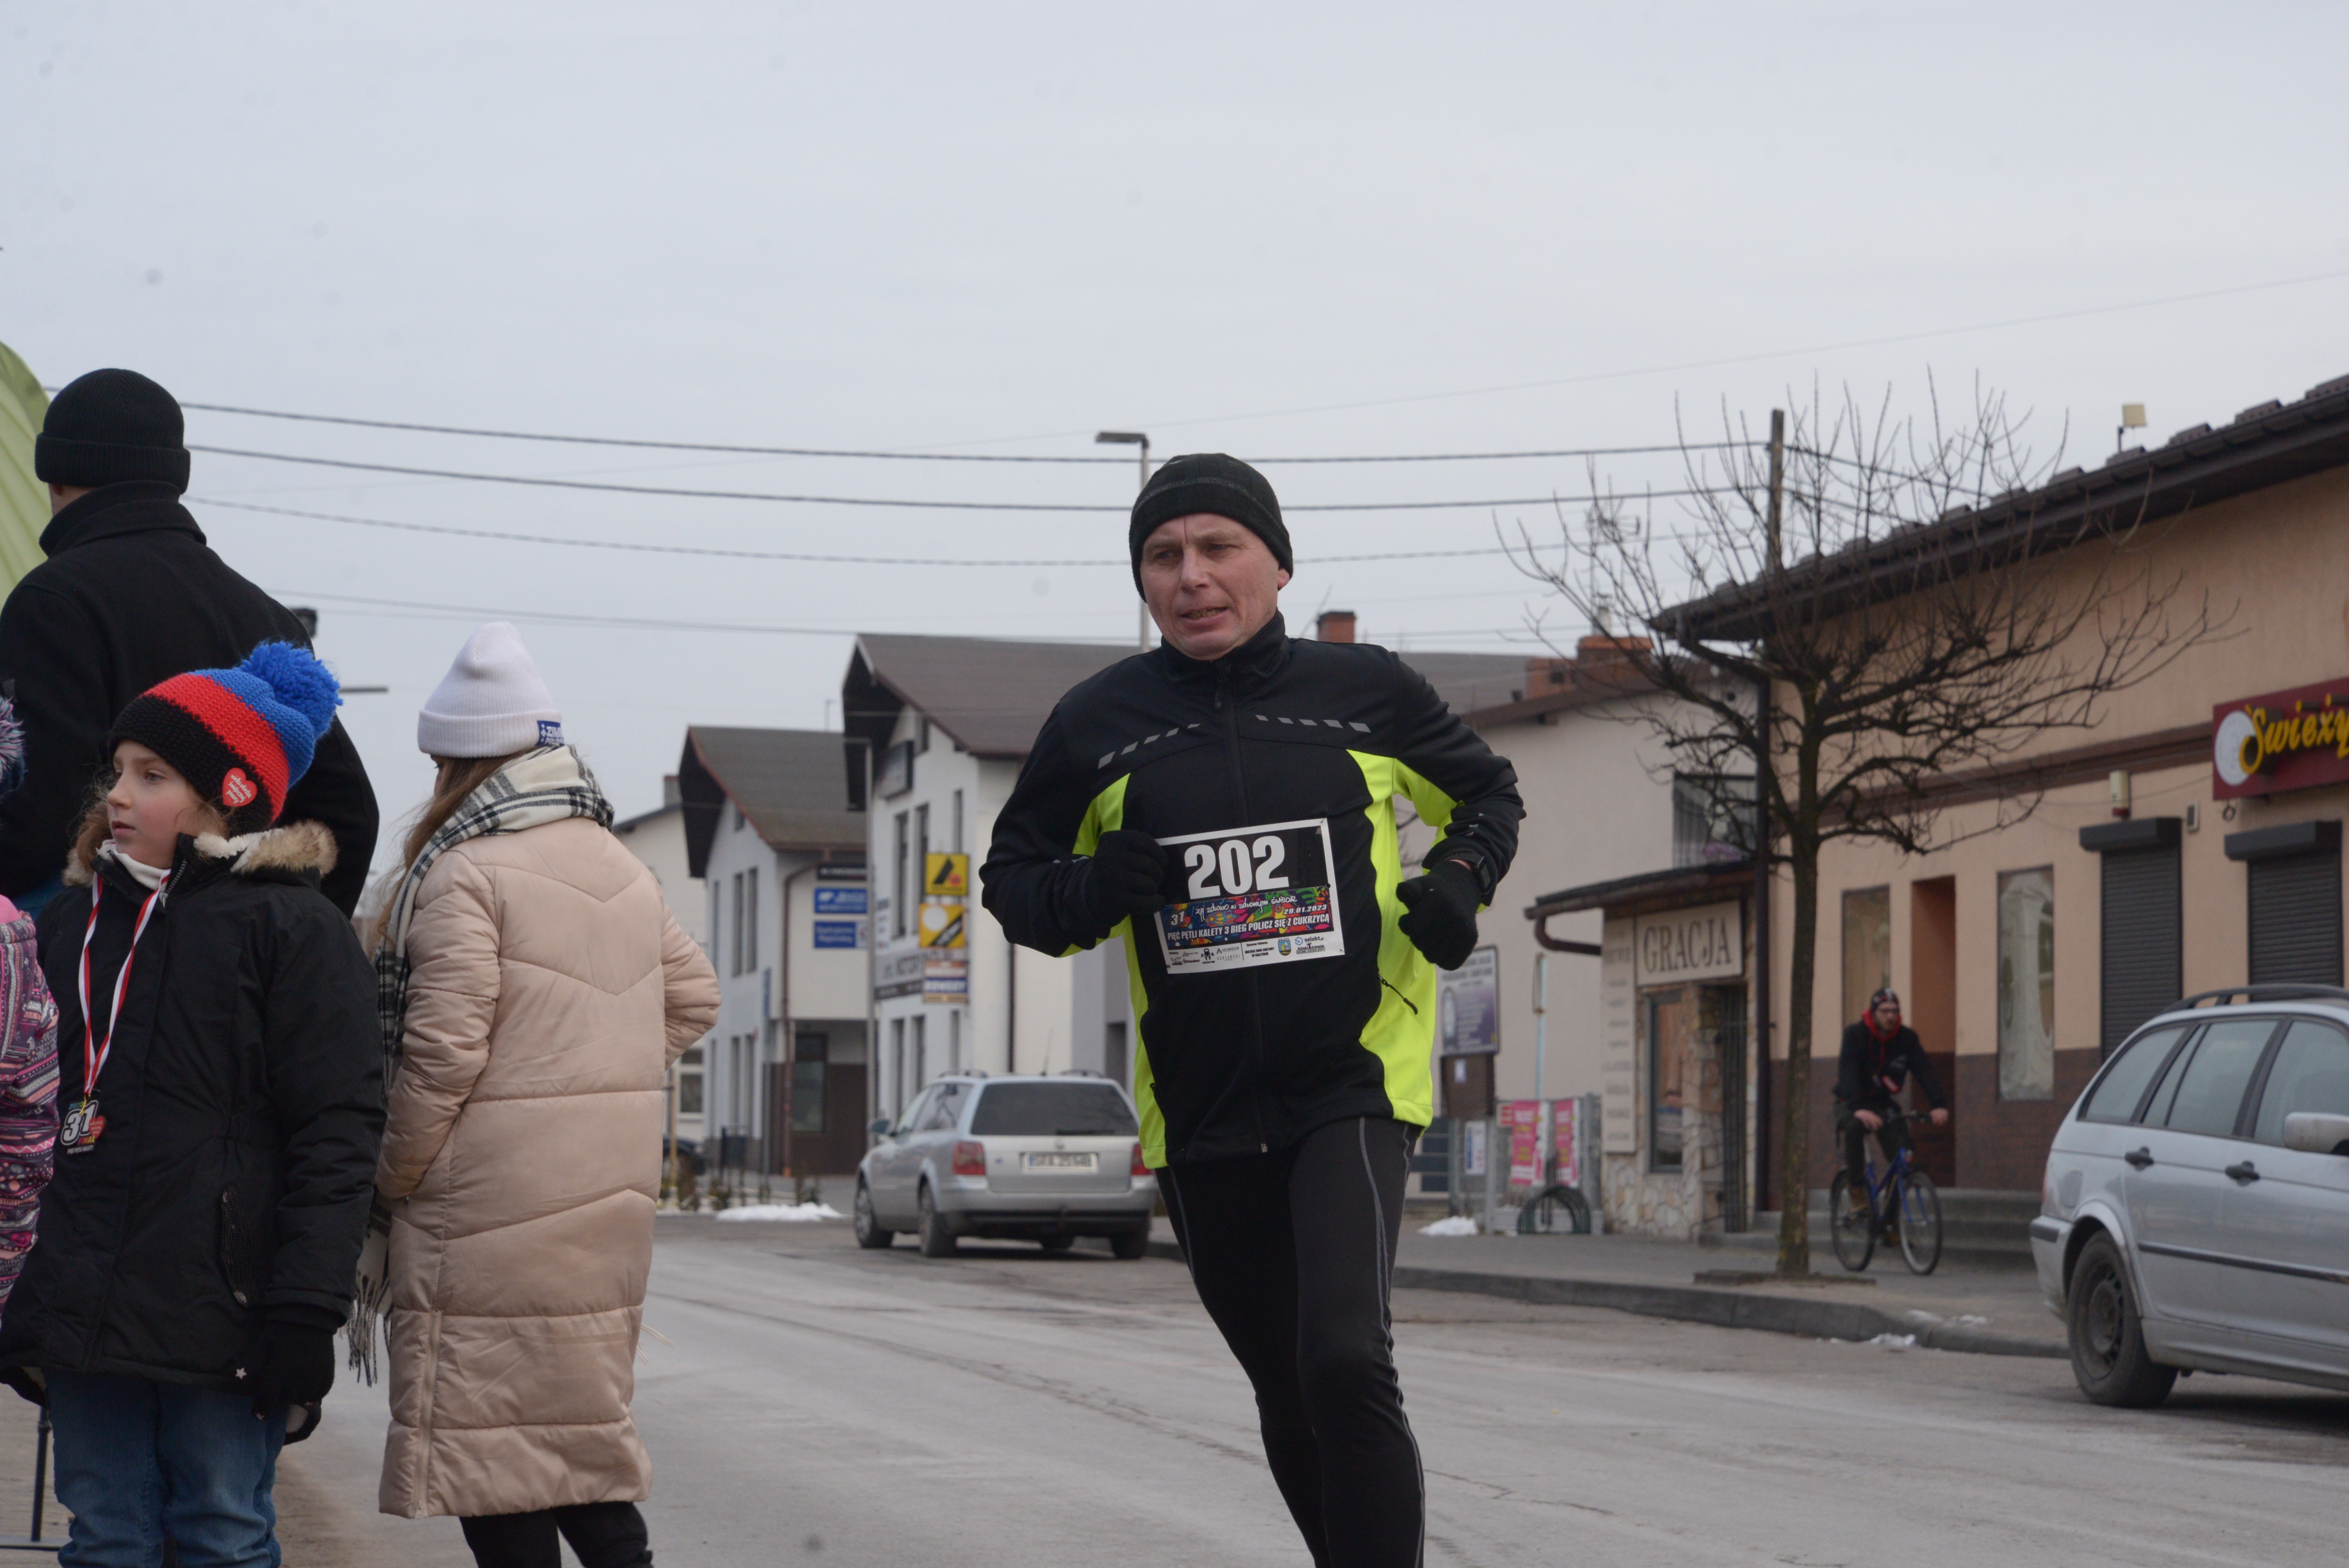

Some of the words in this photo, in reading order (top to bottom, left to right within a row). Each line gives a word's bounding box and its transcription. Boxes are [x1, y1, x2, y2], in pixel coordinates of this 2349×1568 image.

[1184, 835, 1289, 900] 202
[1170, 910, 1185, 927] 31
[1207, 903, 1229, 913] zdrowo
[1239, 898, 1268, 913] zdrowym
[1283, 904, 1327, 915] 29.01.2023
[1167, 930, 1180, 941] PIĘĆ
[1182, 929, 1197, 941] PĘTLI
[1199, 927, 1223, 937] KALETY
[1224, 926, 1229, 934] 3
[1231, 923, 1247, 934] BIEG
[1248, 920, 1273, 931] POLICZ
[1274, 918, 1286, 928] SIĘ
[1293, 914, 1330, 925] CUKRZYCĄ
[1643, 917, 1731, 973] GRACJA
[62, 1102, 97, 1144] 31
